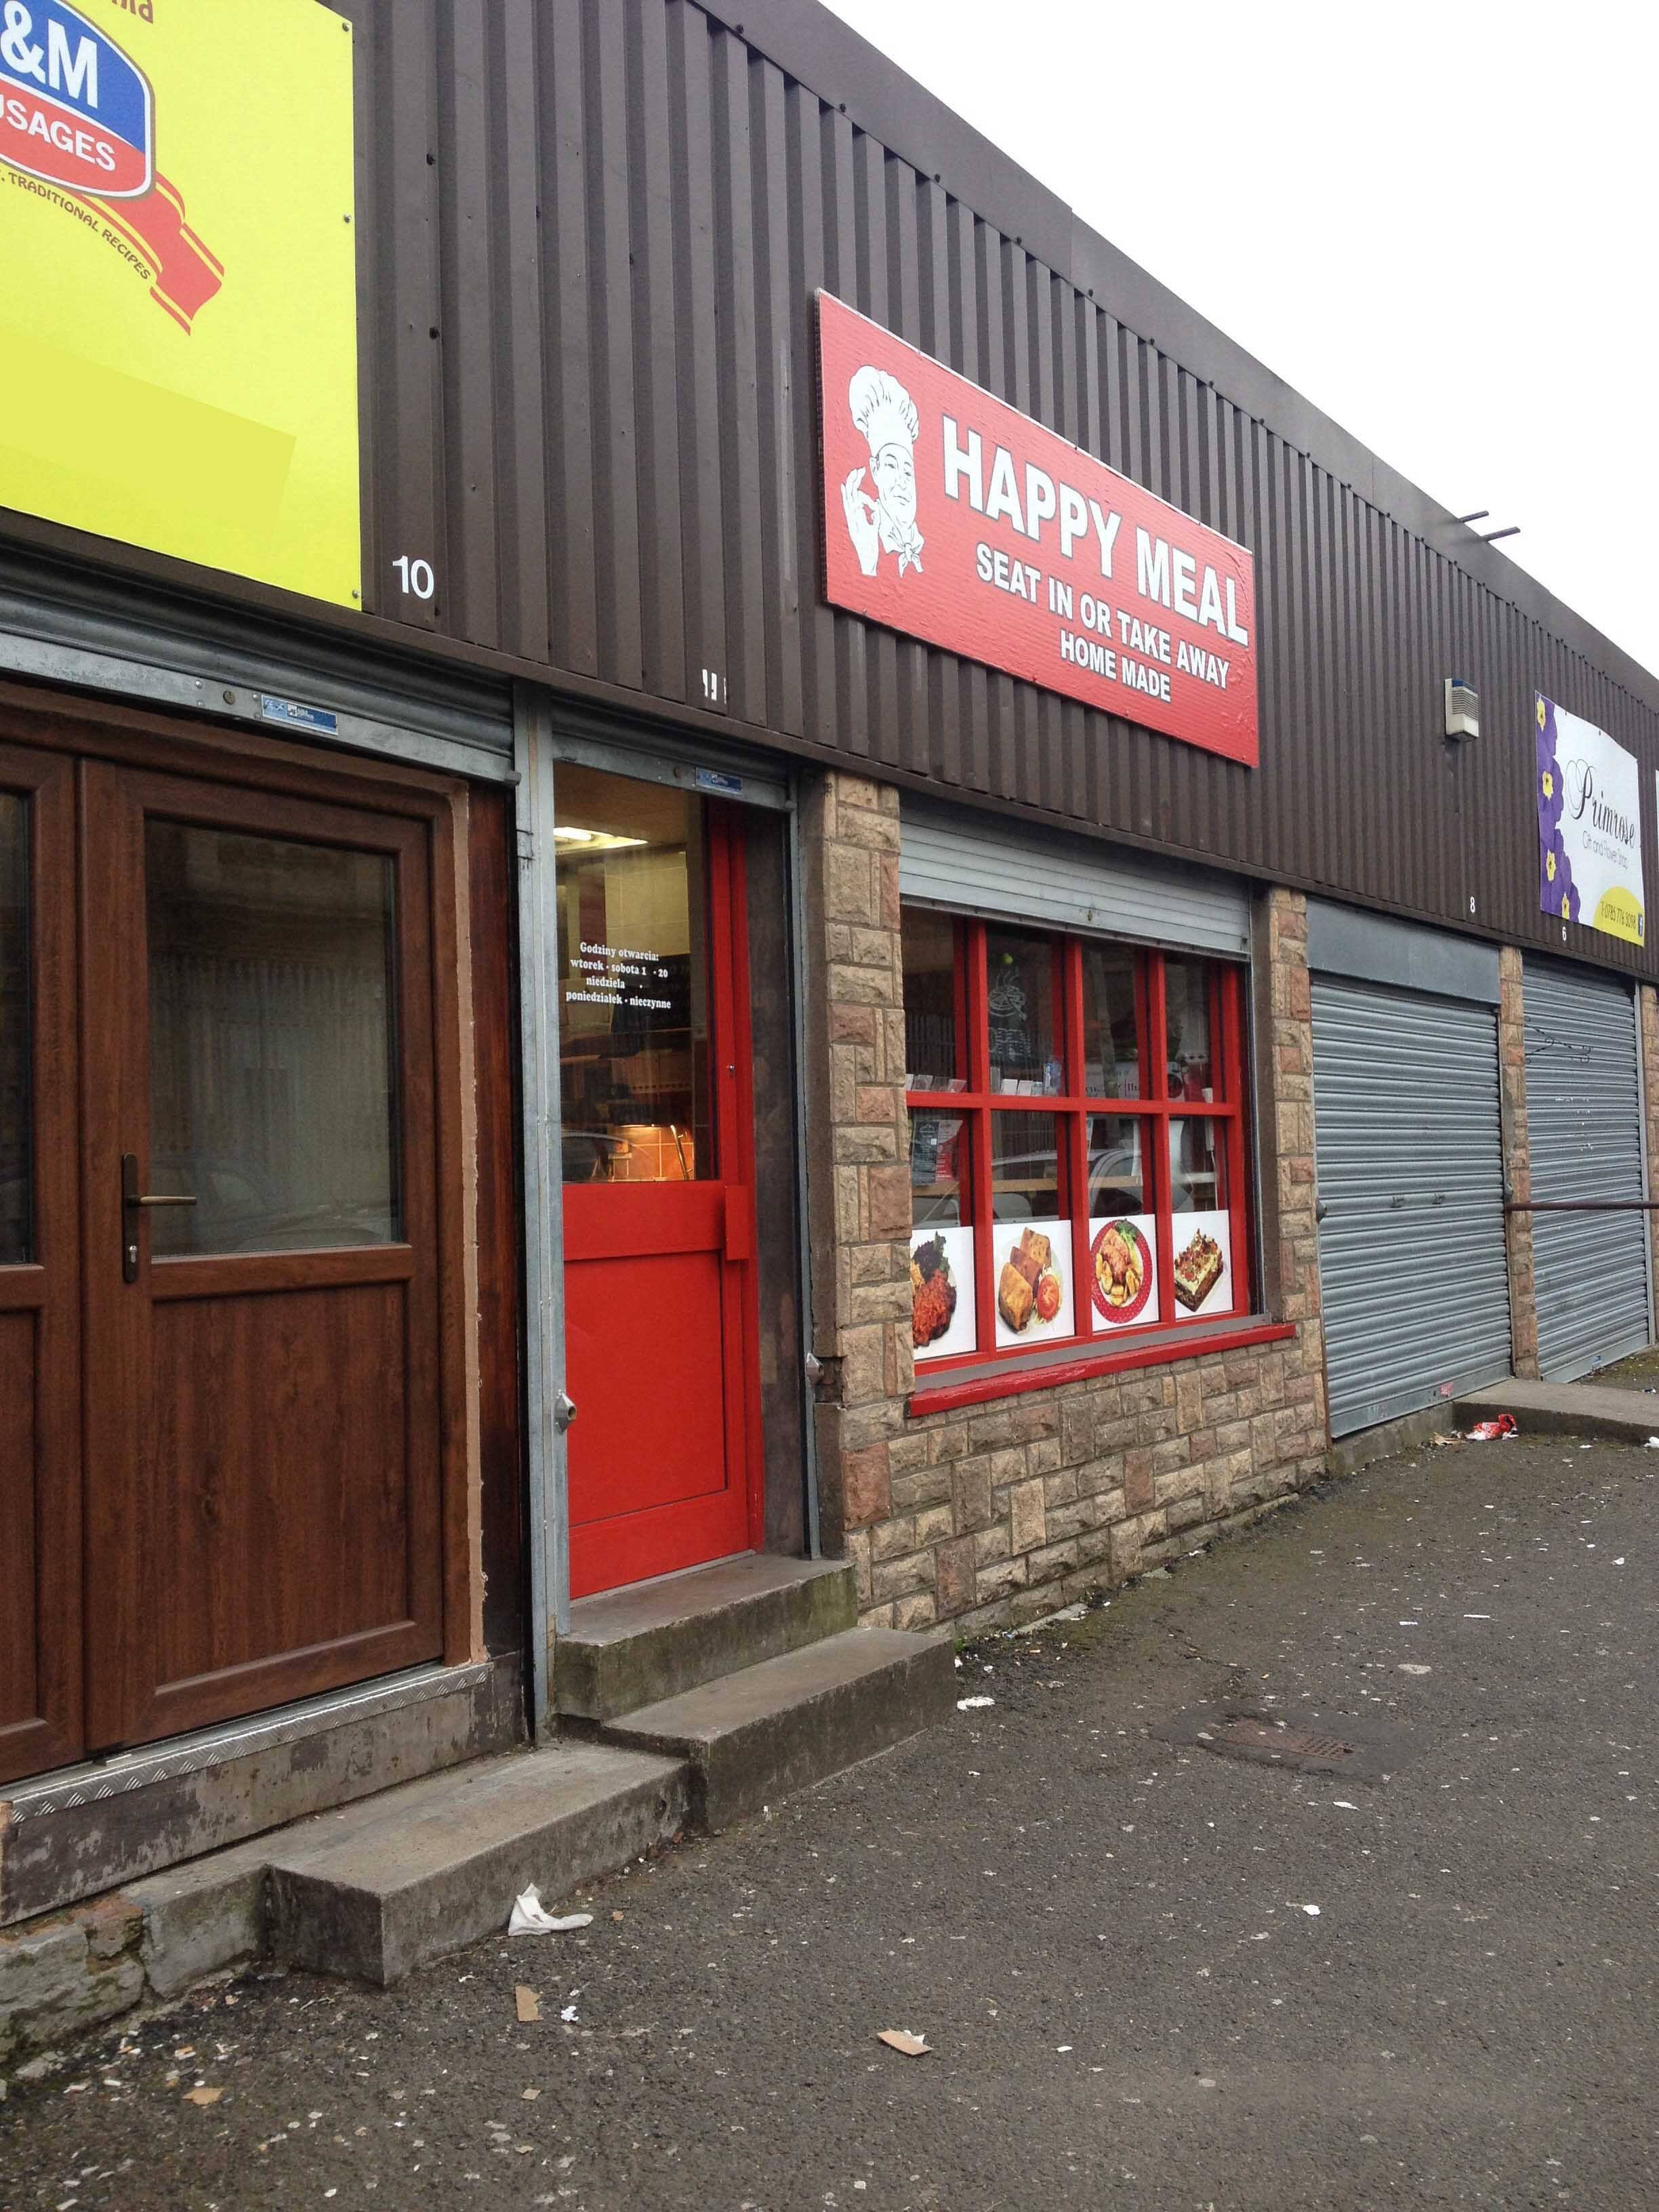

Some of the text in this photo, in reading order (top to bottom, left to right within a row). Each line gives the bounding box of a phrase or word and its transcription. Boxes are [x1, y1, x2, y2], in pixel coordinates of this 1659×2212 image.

[0, 94, 116, 172] SAGES
[8, 171, 150, 280] TRADITIONAL RECIPES
[942, 413, 1248, 647] HAPPY MEAL
[392, 555, 434, 599] 10
[976, 542, 1230, 689] SEAT IN OR TAKE AWAY
[1061, 629, 1171, 703] HOME MADE
[1565, 758, 1636, 849] Primrose
[1470, 896, 1475, 914] 8
[580, 942, 616, 958] Godziny
[1562, 926, 1567, 941] 6
[570, 958, 604, 970] wtorek
[611, 963, 639, 975] sobota
[658, 969, 668, 978] 20
[586, 975, 626, 989] niedziela
[630, 996, 671, 1009] nieczynne
